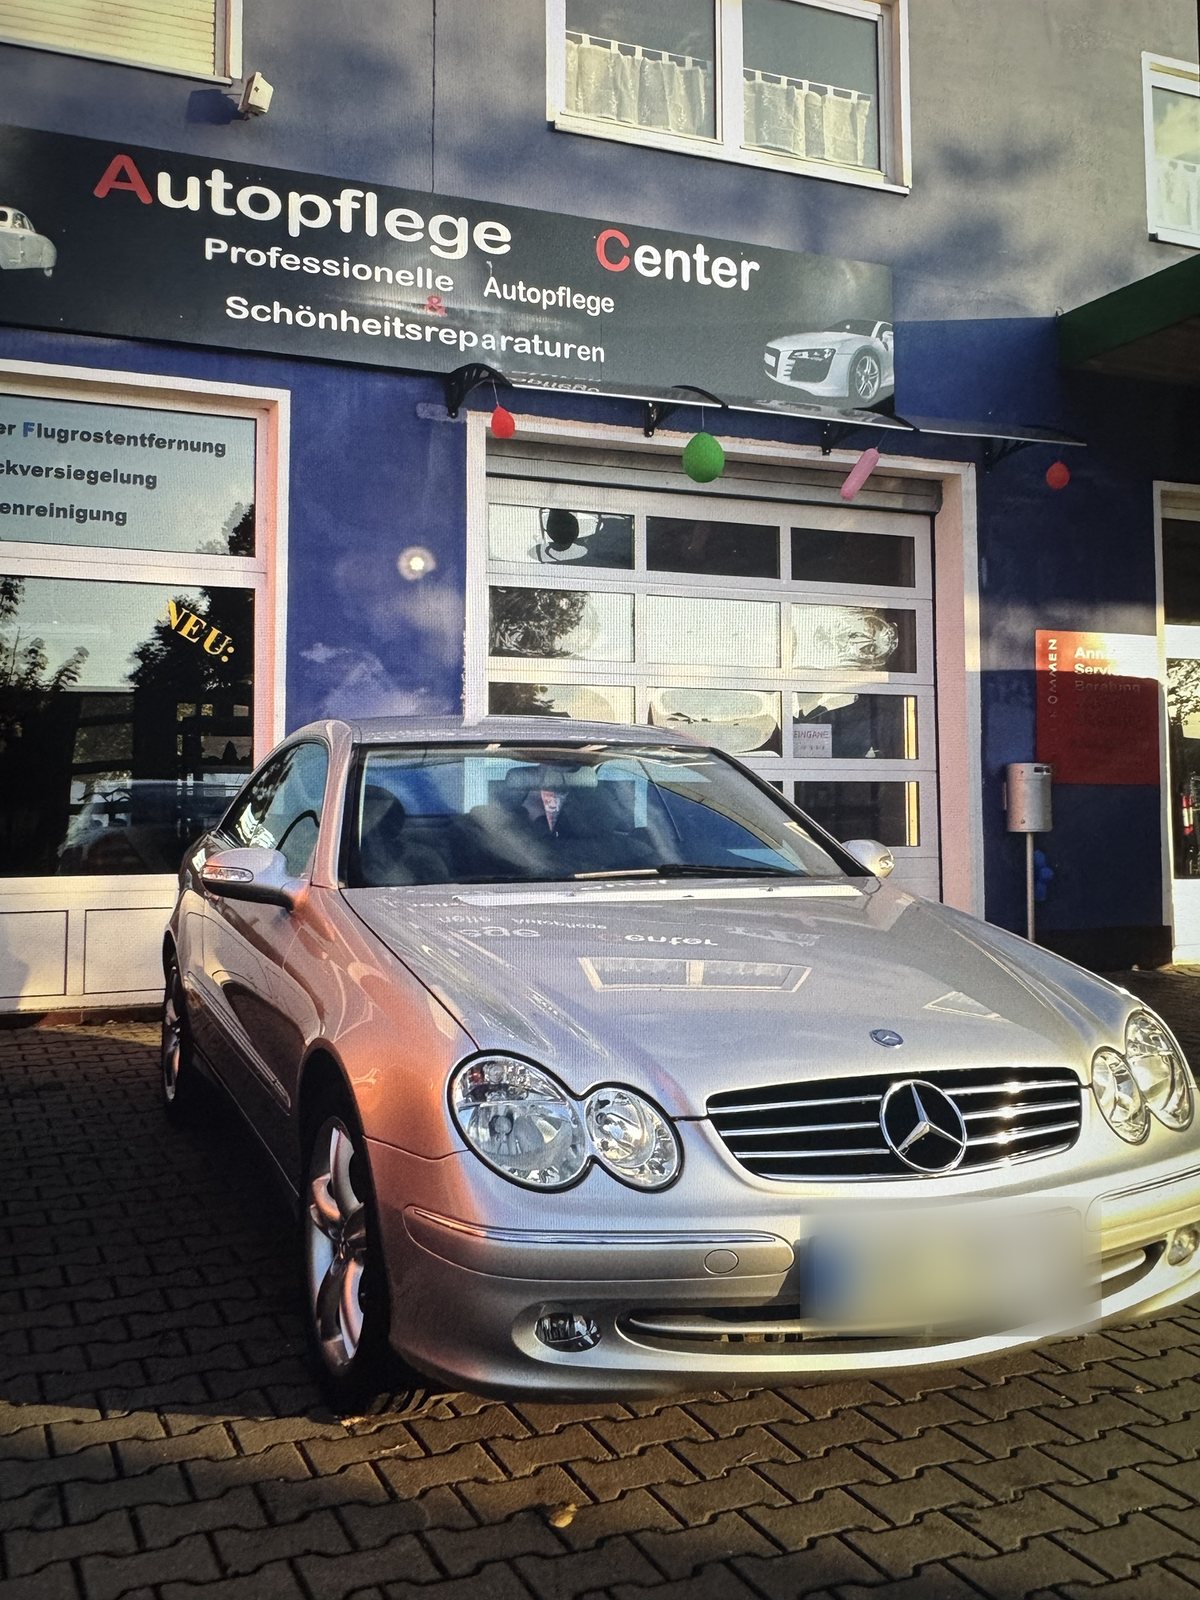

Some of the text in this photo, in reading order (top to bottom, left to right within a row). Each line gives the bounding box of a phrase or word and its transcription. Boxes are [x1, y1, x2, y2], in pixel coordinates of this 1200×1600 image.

[93, 154, 760, 291] Autopflege Center
[205, 238, 615, 317] Professionelle Autopflege
[225, 296, 605, 364] Schönheitsreparaturen
[424, 295, 447, 317] &
[23, 422, 226, 457] Flugrostentfernung
[0, 503, 127, 526] enreinigung
